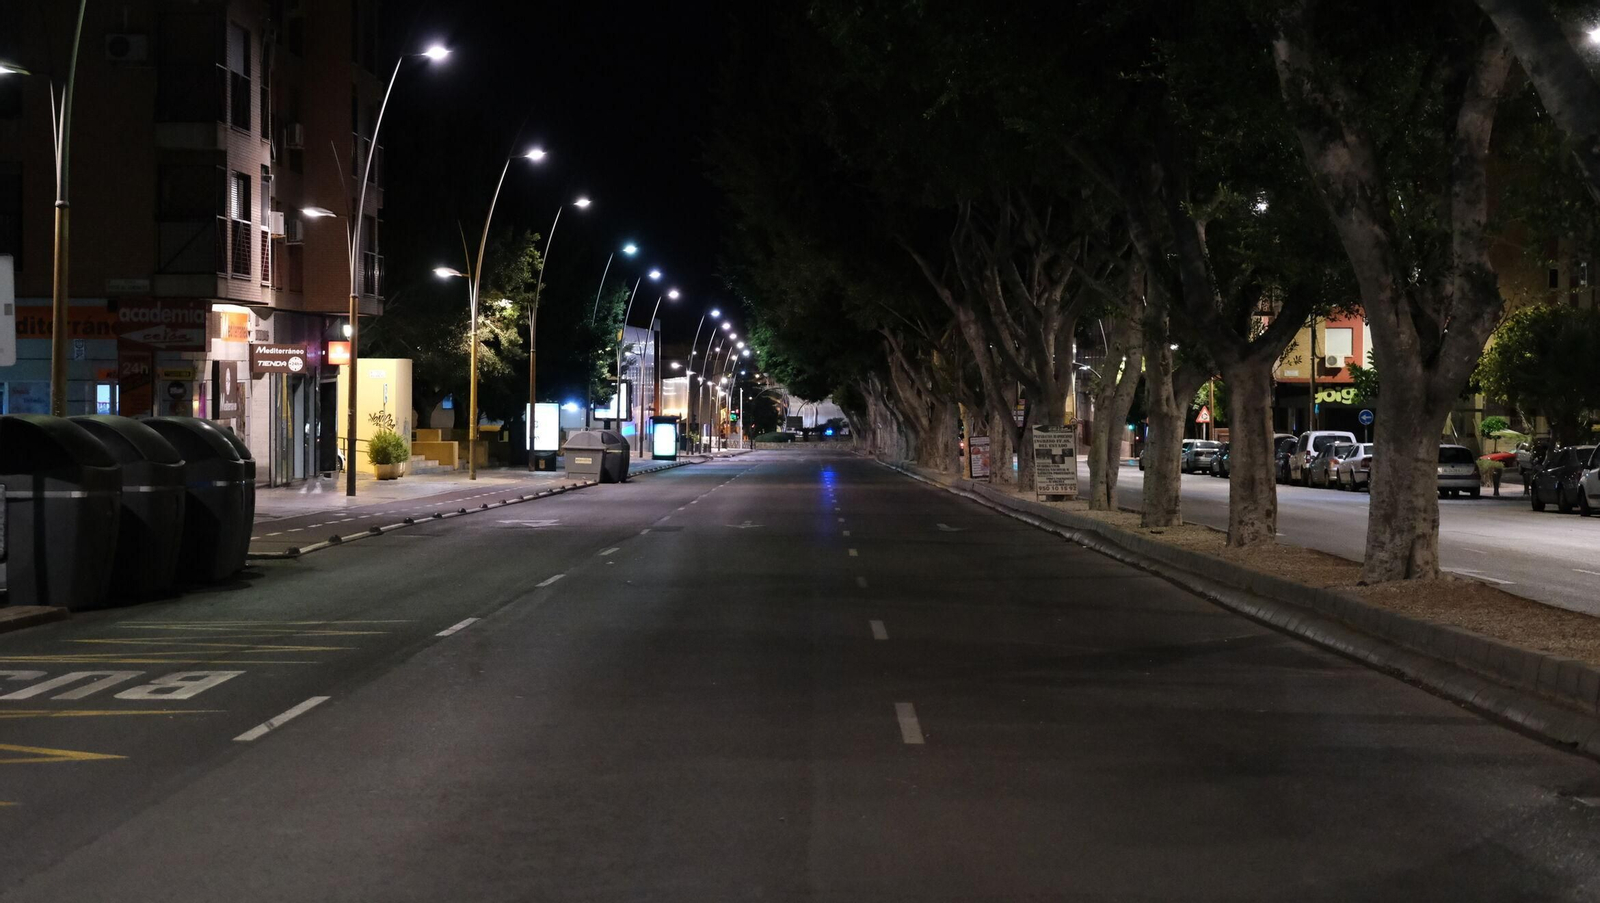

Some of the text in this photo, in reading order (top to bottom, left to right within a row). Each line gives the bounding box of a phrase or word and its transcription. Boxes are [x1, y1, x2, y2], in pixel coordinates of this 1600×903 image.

[119, 301, 205, 323] academia
[256, 346, 305, 355] Mediterráneo
[122, 362, 149, 375] 24h
